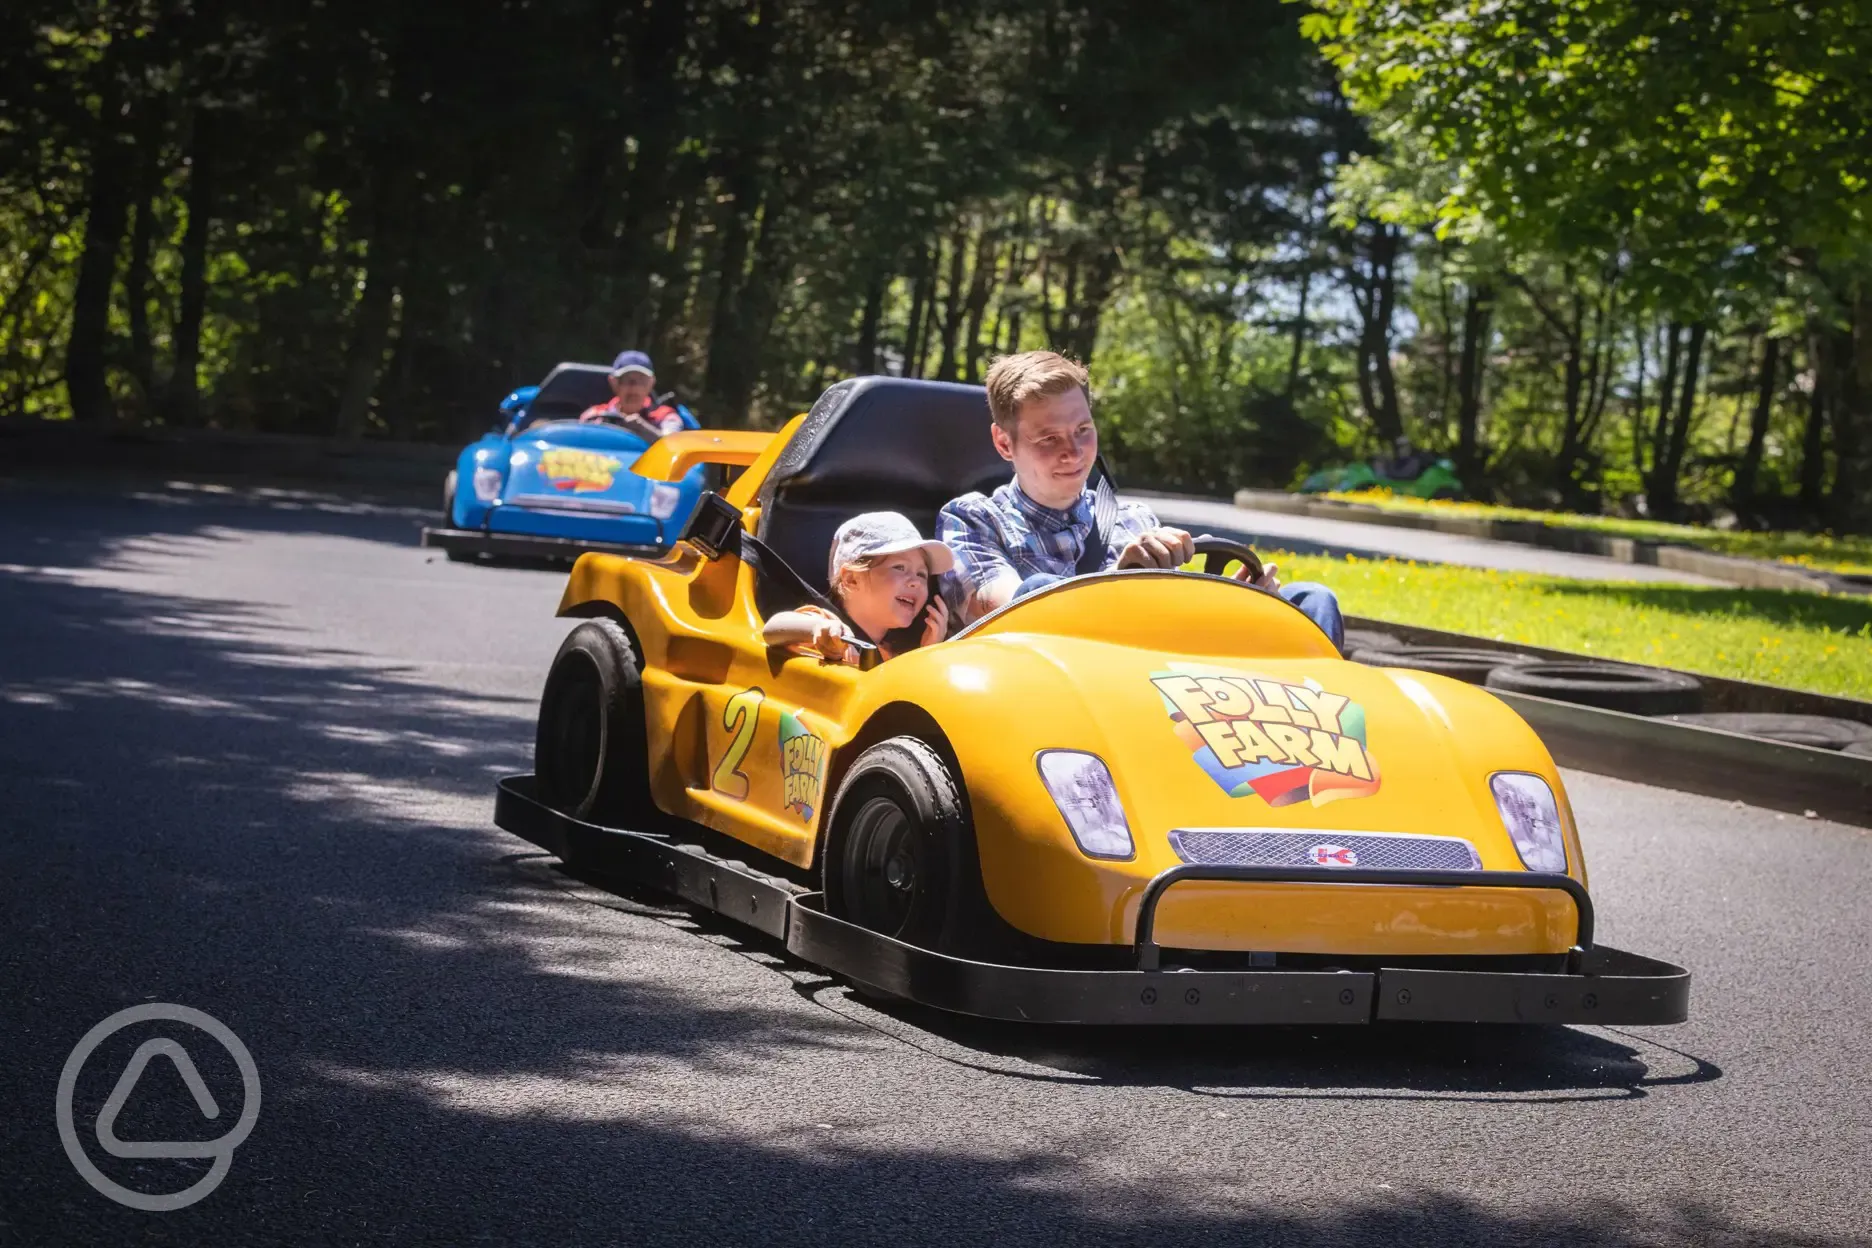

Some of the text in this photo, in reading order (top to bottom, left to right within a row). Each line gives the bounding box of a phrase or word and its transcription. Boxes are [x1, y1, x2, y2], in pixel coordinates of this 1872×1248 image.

[1150, 675, 1349, 735] FOLLY
[712, 686, 765, 802] 2
[784, 734, 825, 779] FOLLY
[1195, 719, 1375, 782] FARM
[784, 772, 818, 809] FARM
